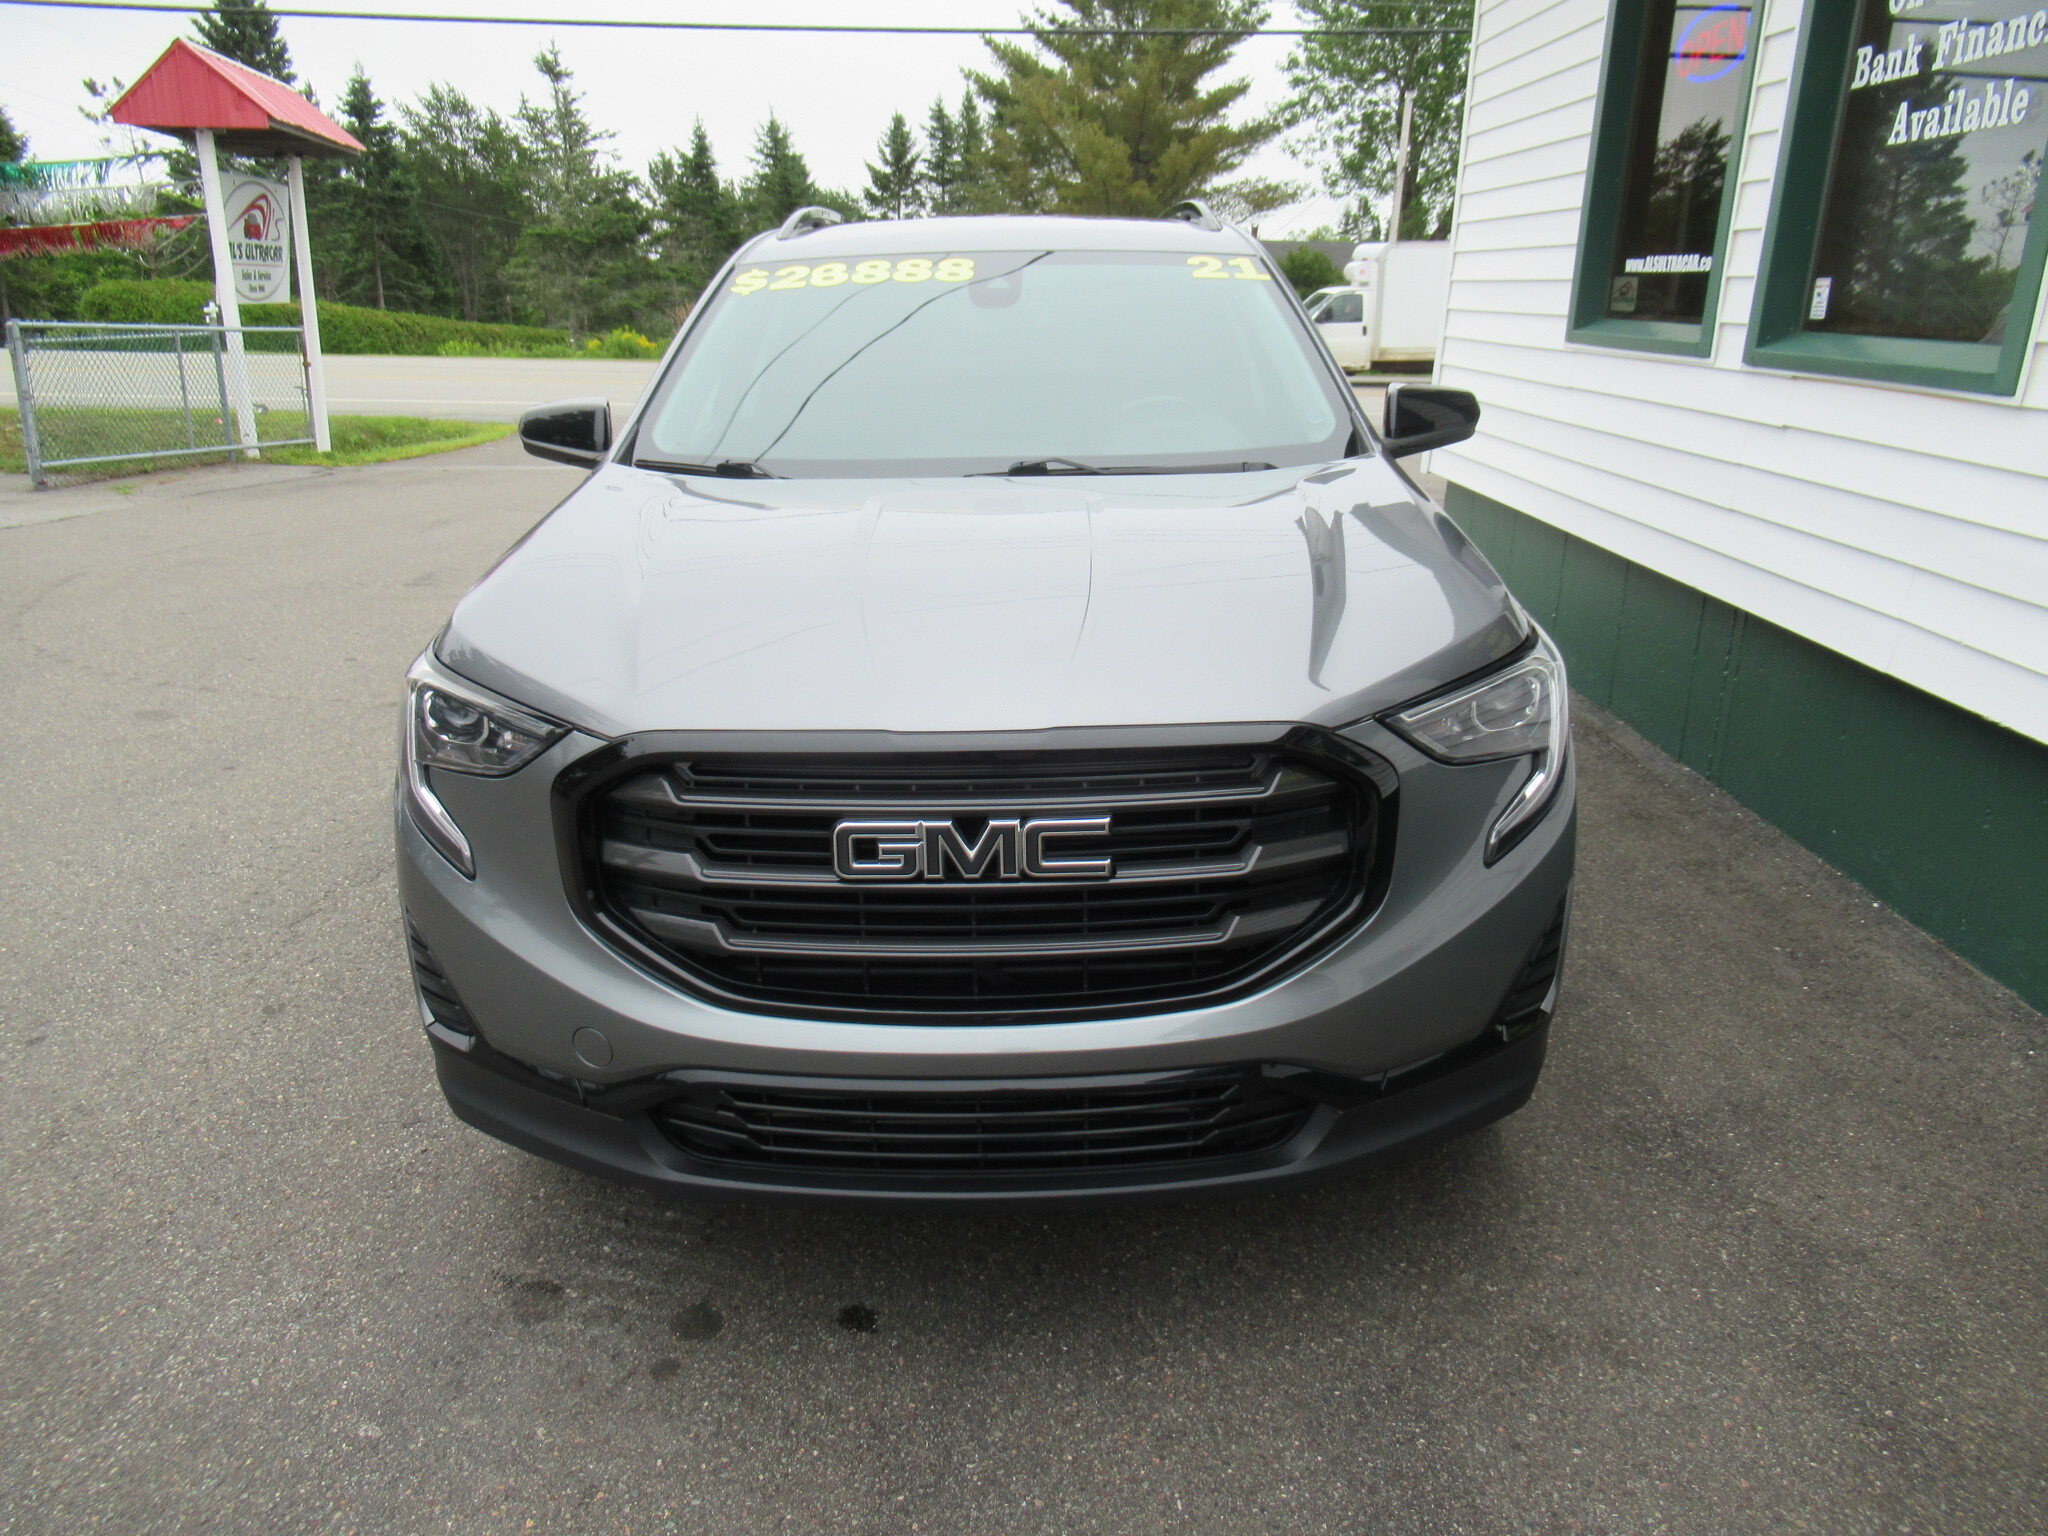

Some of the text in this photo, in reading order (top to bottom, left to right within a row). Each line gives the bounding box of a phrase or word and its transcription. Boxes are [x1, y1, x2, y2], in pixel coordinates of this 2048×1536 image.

[1677, 9, 1747, 77] OPEN
[1850, 33, 1923, 90] Bank
[1886, 77, 2029, 146] Available
[730, 257, 975, 296] $28888
[1186, 255, 1272, 281] 21
[832, 814, 1113, 881] GMC
